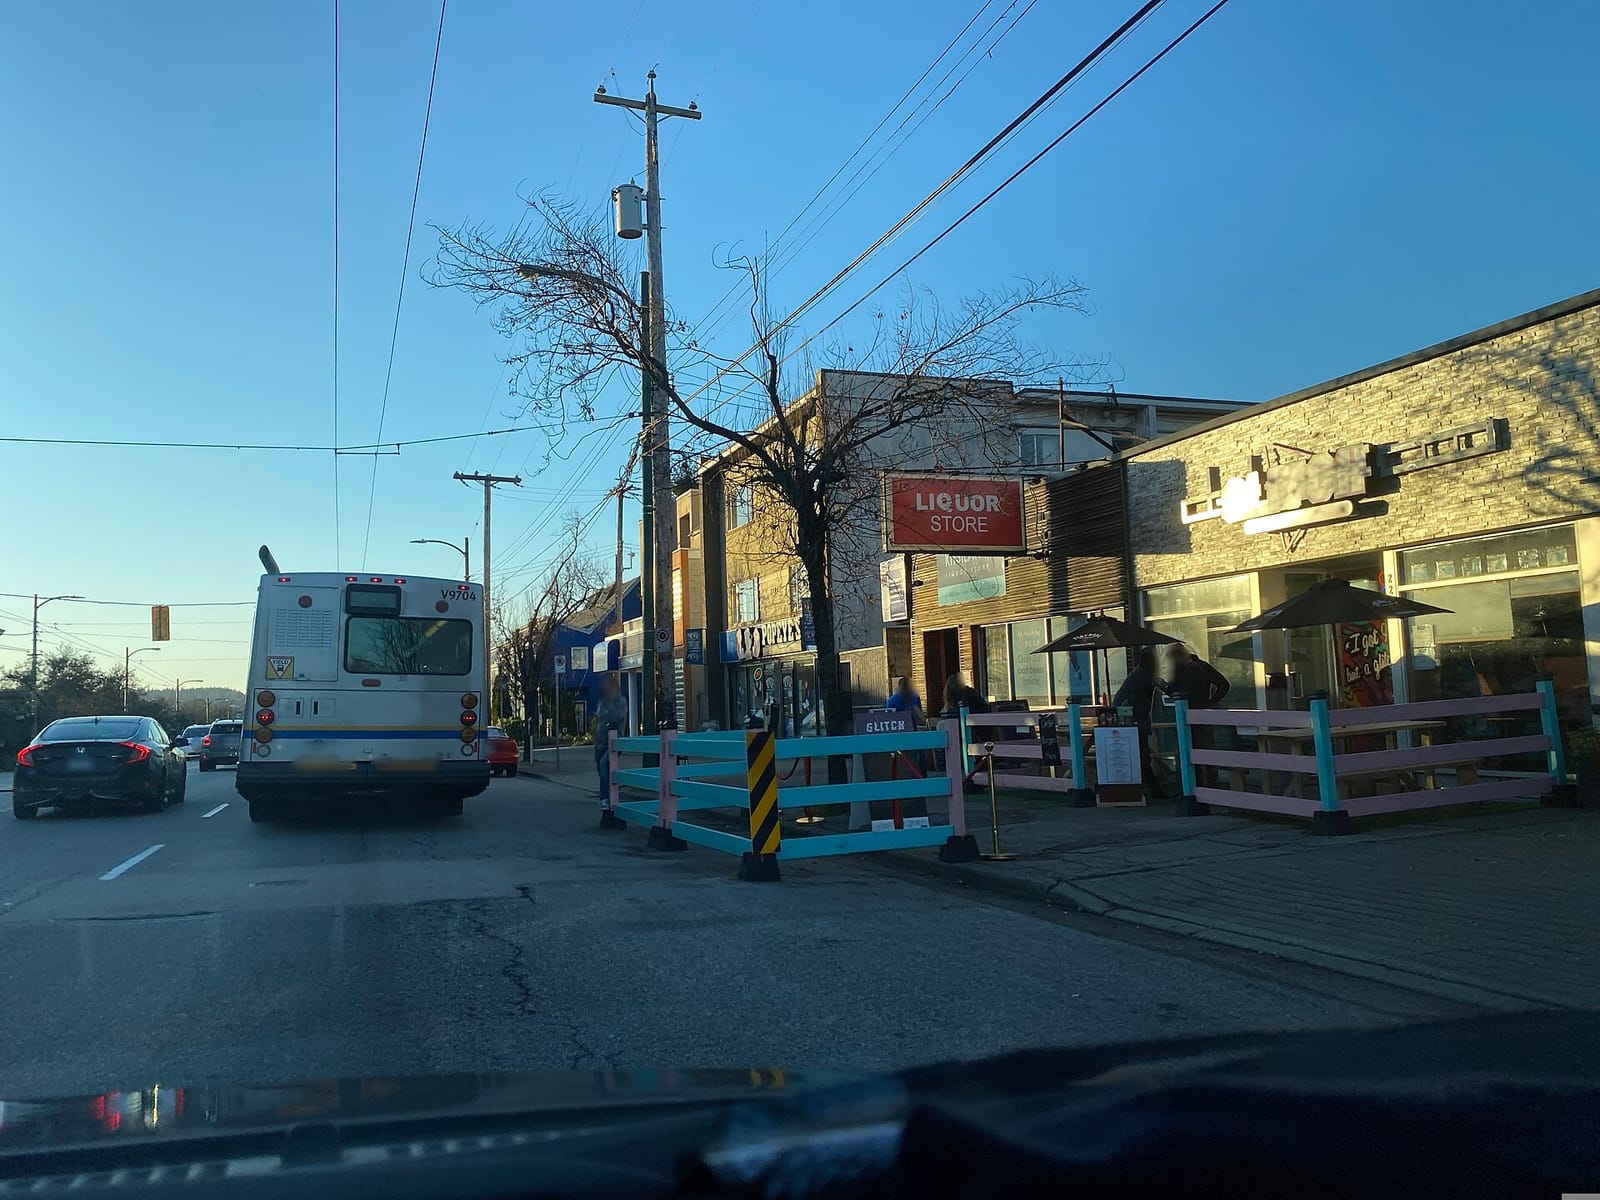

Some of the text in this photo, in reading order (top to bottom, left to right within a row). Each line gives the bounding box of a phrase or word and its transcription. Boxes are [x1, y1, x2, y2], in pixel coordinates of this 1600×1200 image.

[916, 492, 1000, 512] LIQUOR
[930, 515, 989, 533] STORE
[440, 589, 476, 602] V9704
[866, 720, 905, 733] GLITCH
